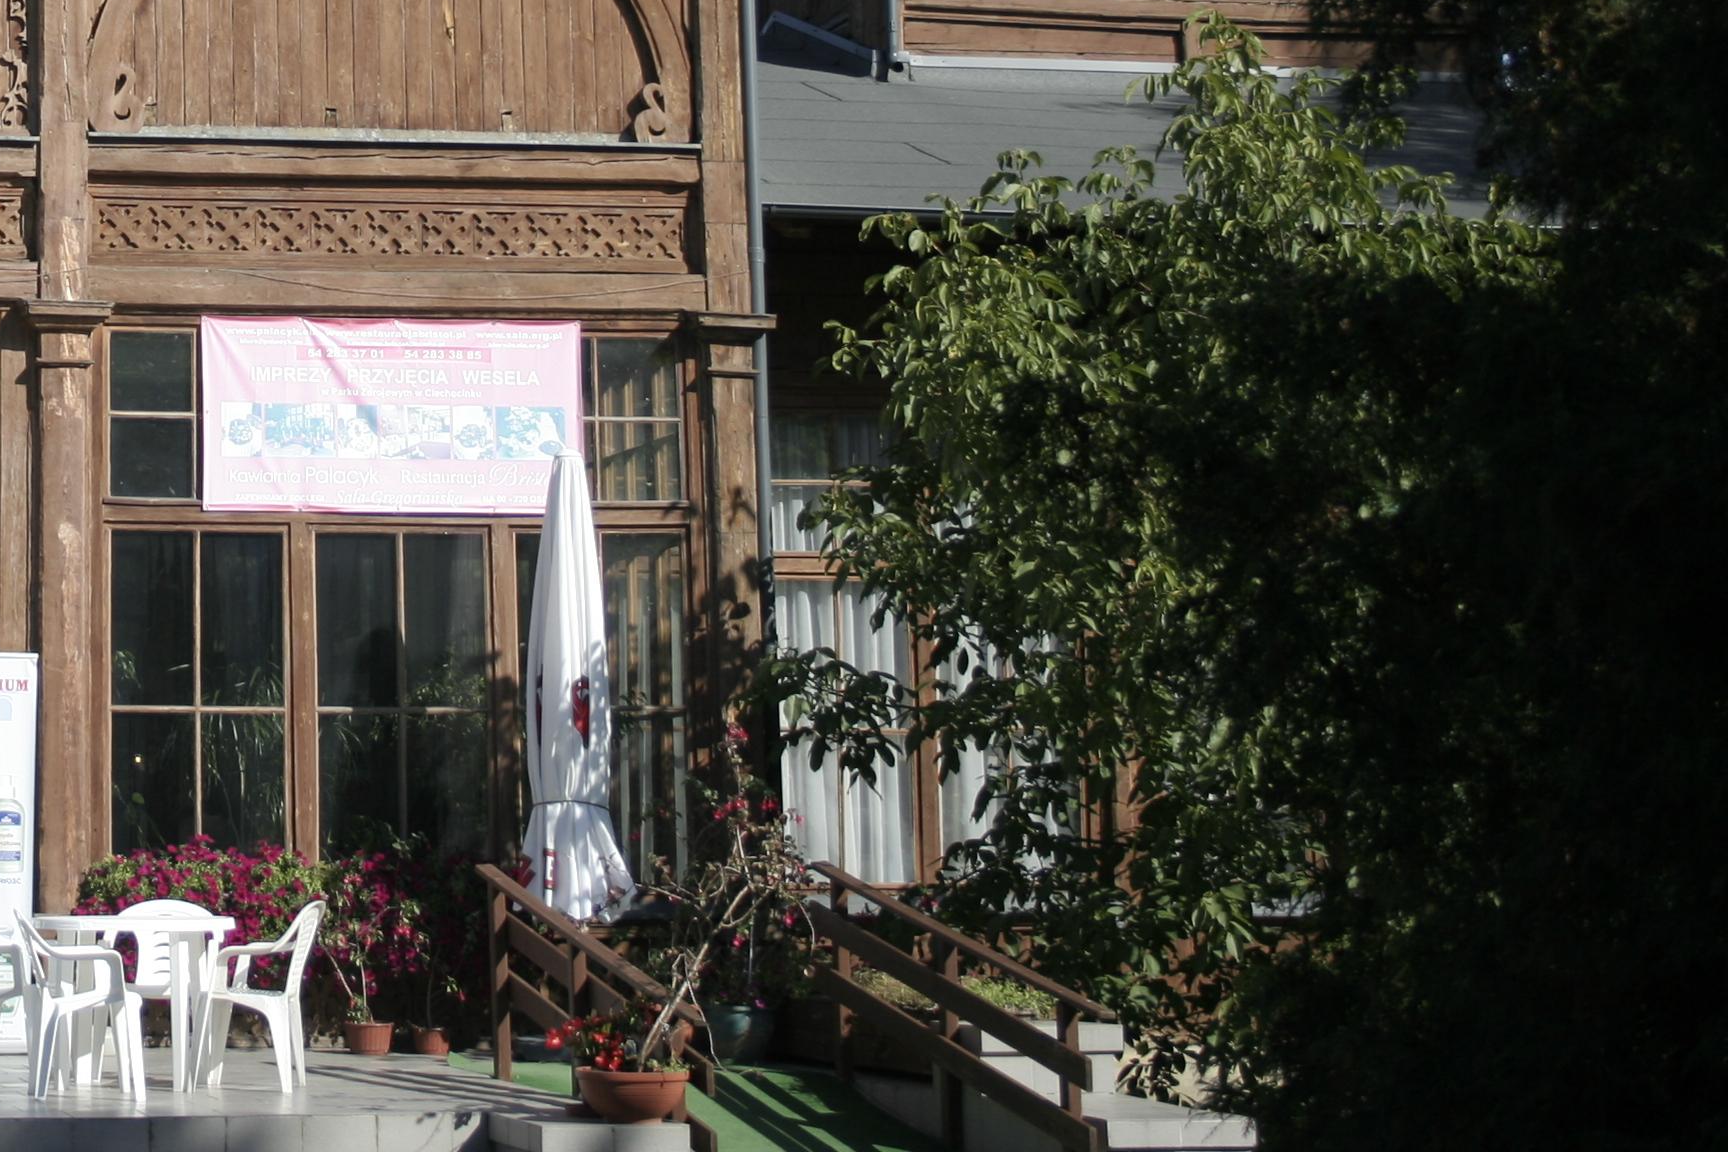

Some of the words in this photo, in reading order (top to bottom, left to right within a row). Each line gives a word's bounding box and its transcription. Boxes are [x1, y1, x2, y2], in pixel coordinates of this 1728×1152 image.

[353, 349, 365, 359] 37
[371, 349, 384, 359] 01
[404, 349, 418, 359] 54
[423, 349, 444, 360] 283
[448, 350, 463, 360] 38
[251, 366, 332, 383] IMPREZY
[346, 368, 448, 388] PRZYJĘCIA
[462, 370, 540, 386] WESELA
[331, 387, 359, 396] Parku
[361, 388, 412, 399] Zdrojowym
[425, 389, 482, 398] Ciechocinku
[229, 468, 301, 483] Kawiarnia
[399, 468, 485, 488] Restauracja
[336, 489, 366, 505] Sala
